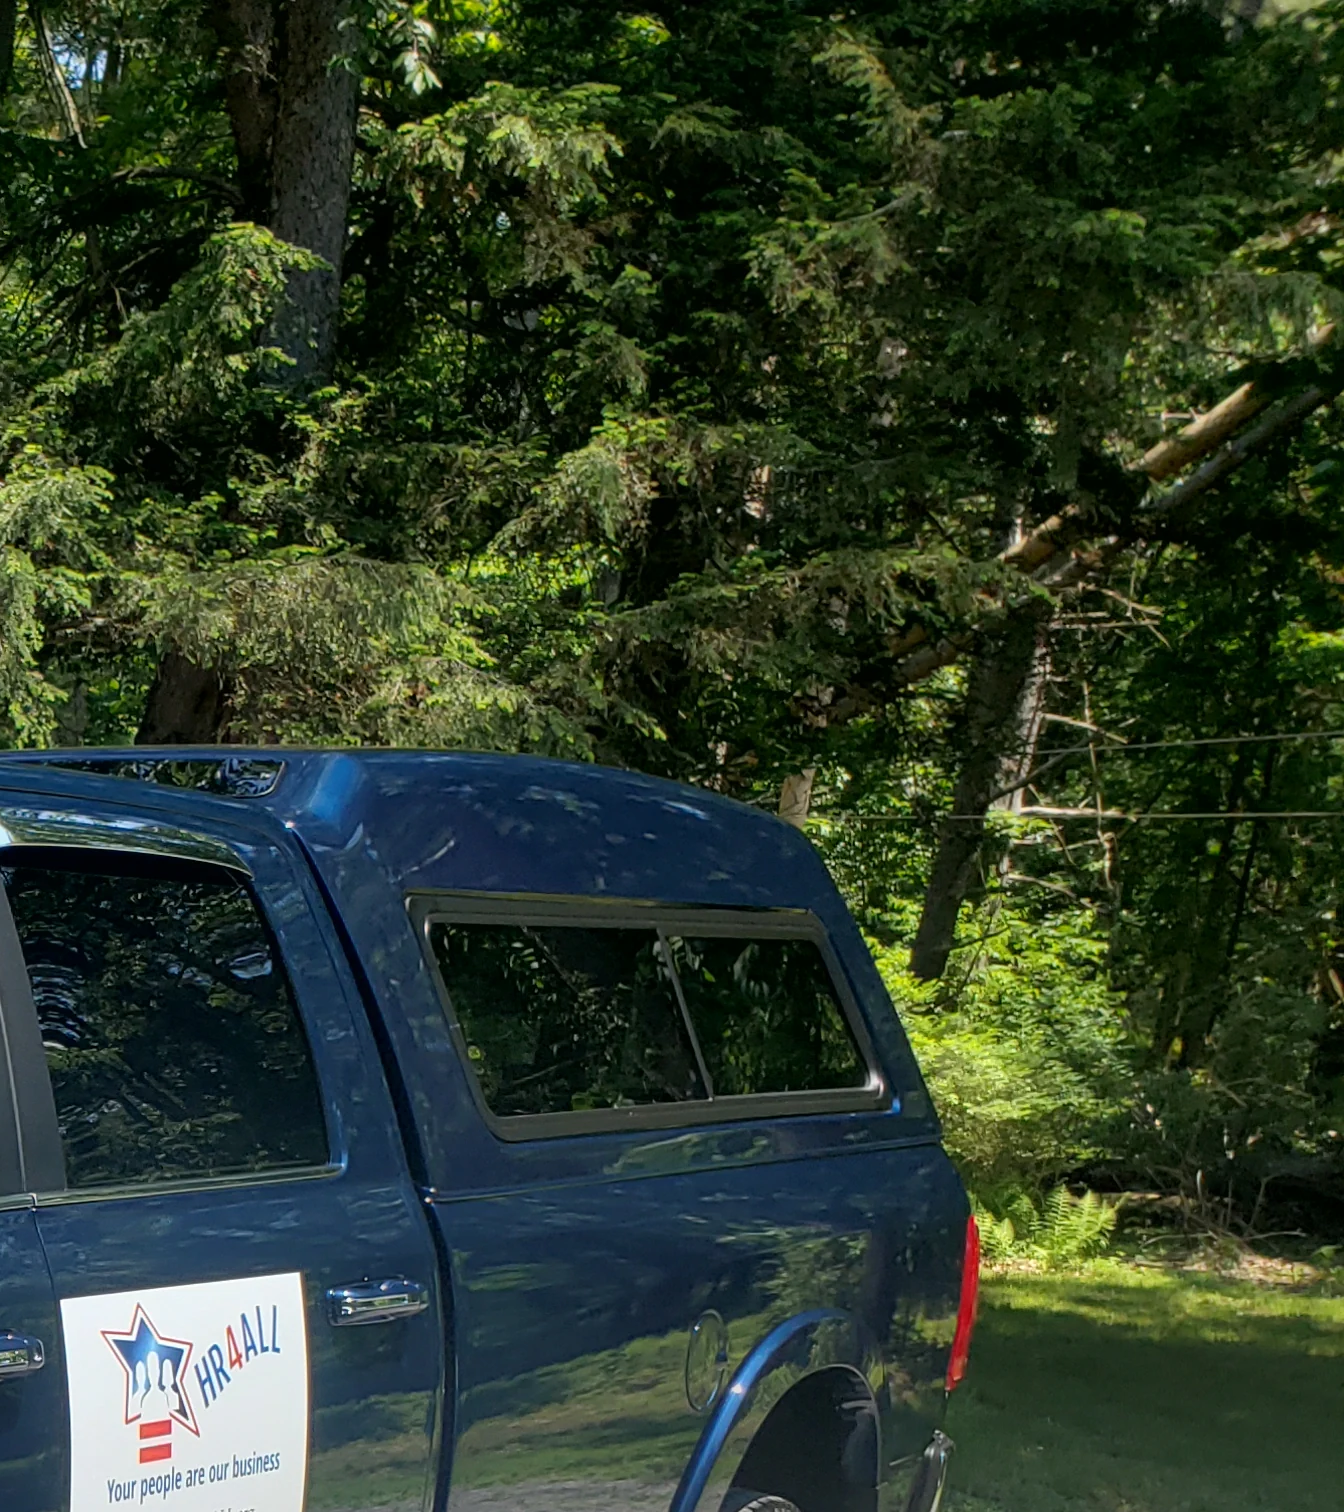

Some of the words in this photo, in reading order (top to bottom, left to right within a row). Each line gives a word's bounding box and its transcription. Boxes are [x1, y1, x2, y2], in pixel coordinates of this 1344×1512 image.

[194, 1305, 281, 1409] HR4ALL
[107, 1479, 137, 1503] Your
[140, 1466, 182, 1505] people
[186, 1467, 205, 1488] are
[209, 1458, 230, 1484] our
[232, 1451, 281, 1478] business
